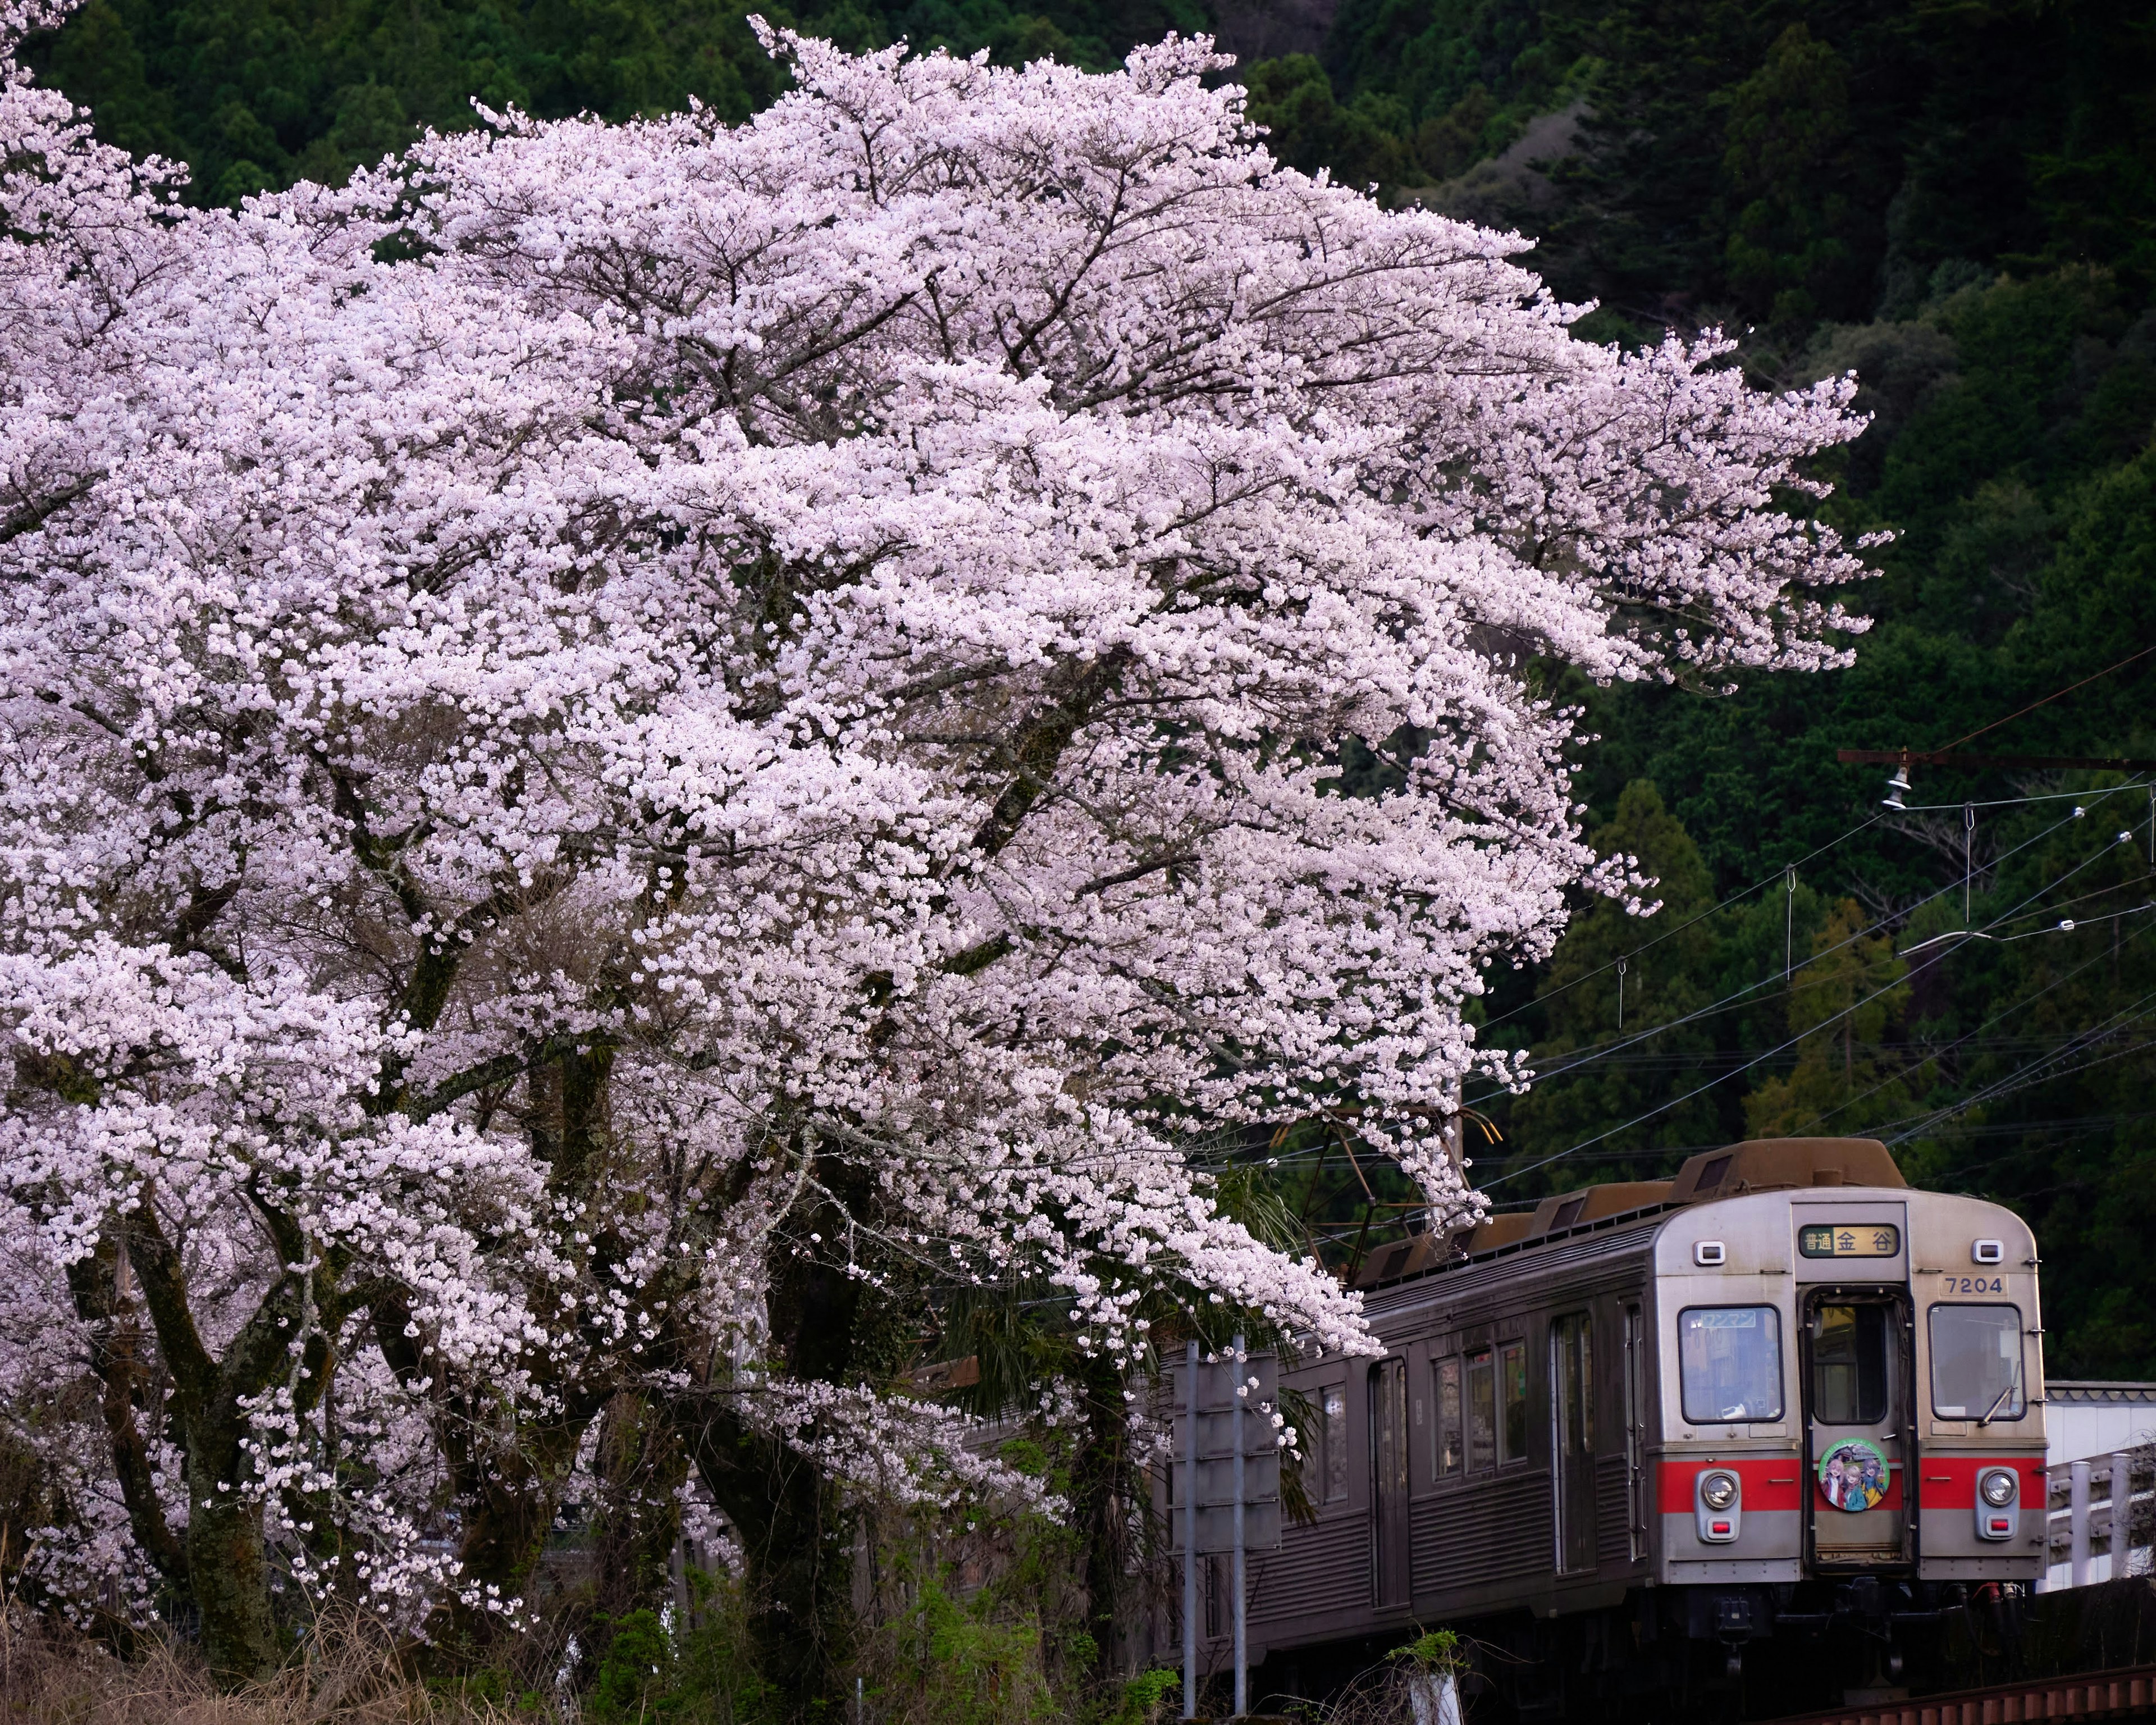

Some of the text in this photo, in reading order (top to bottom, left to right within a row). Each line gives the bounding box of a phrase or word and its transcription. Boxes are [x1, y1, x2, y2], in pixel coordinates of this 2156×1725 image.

[1805, 1231, 1892, 1251] 普通 金谷
[1945, 1278, 2002, 1293] 7204
[1703, 1313, 1754, 1326] ワンマン
